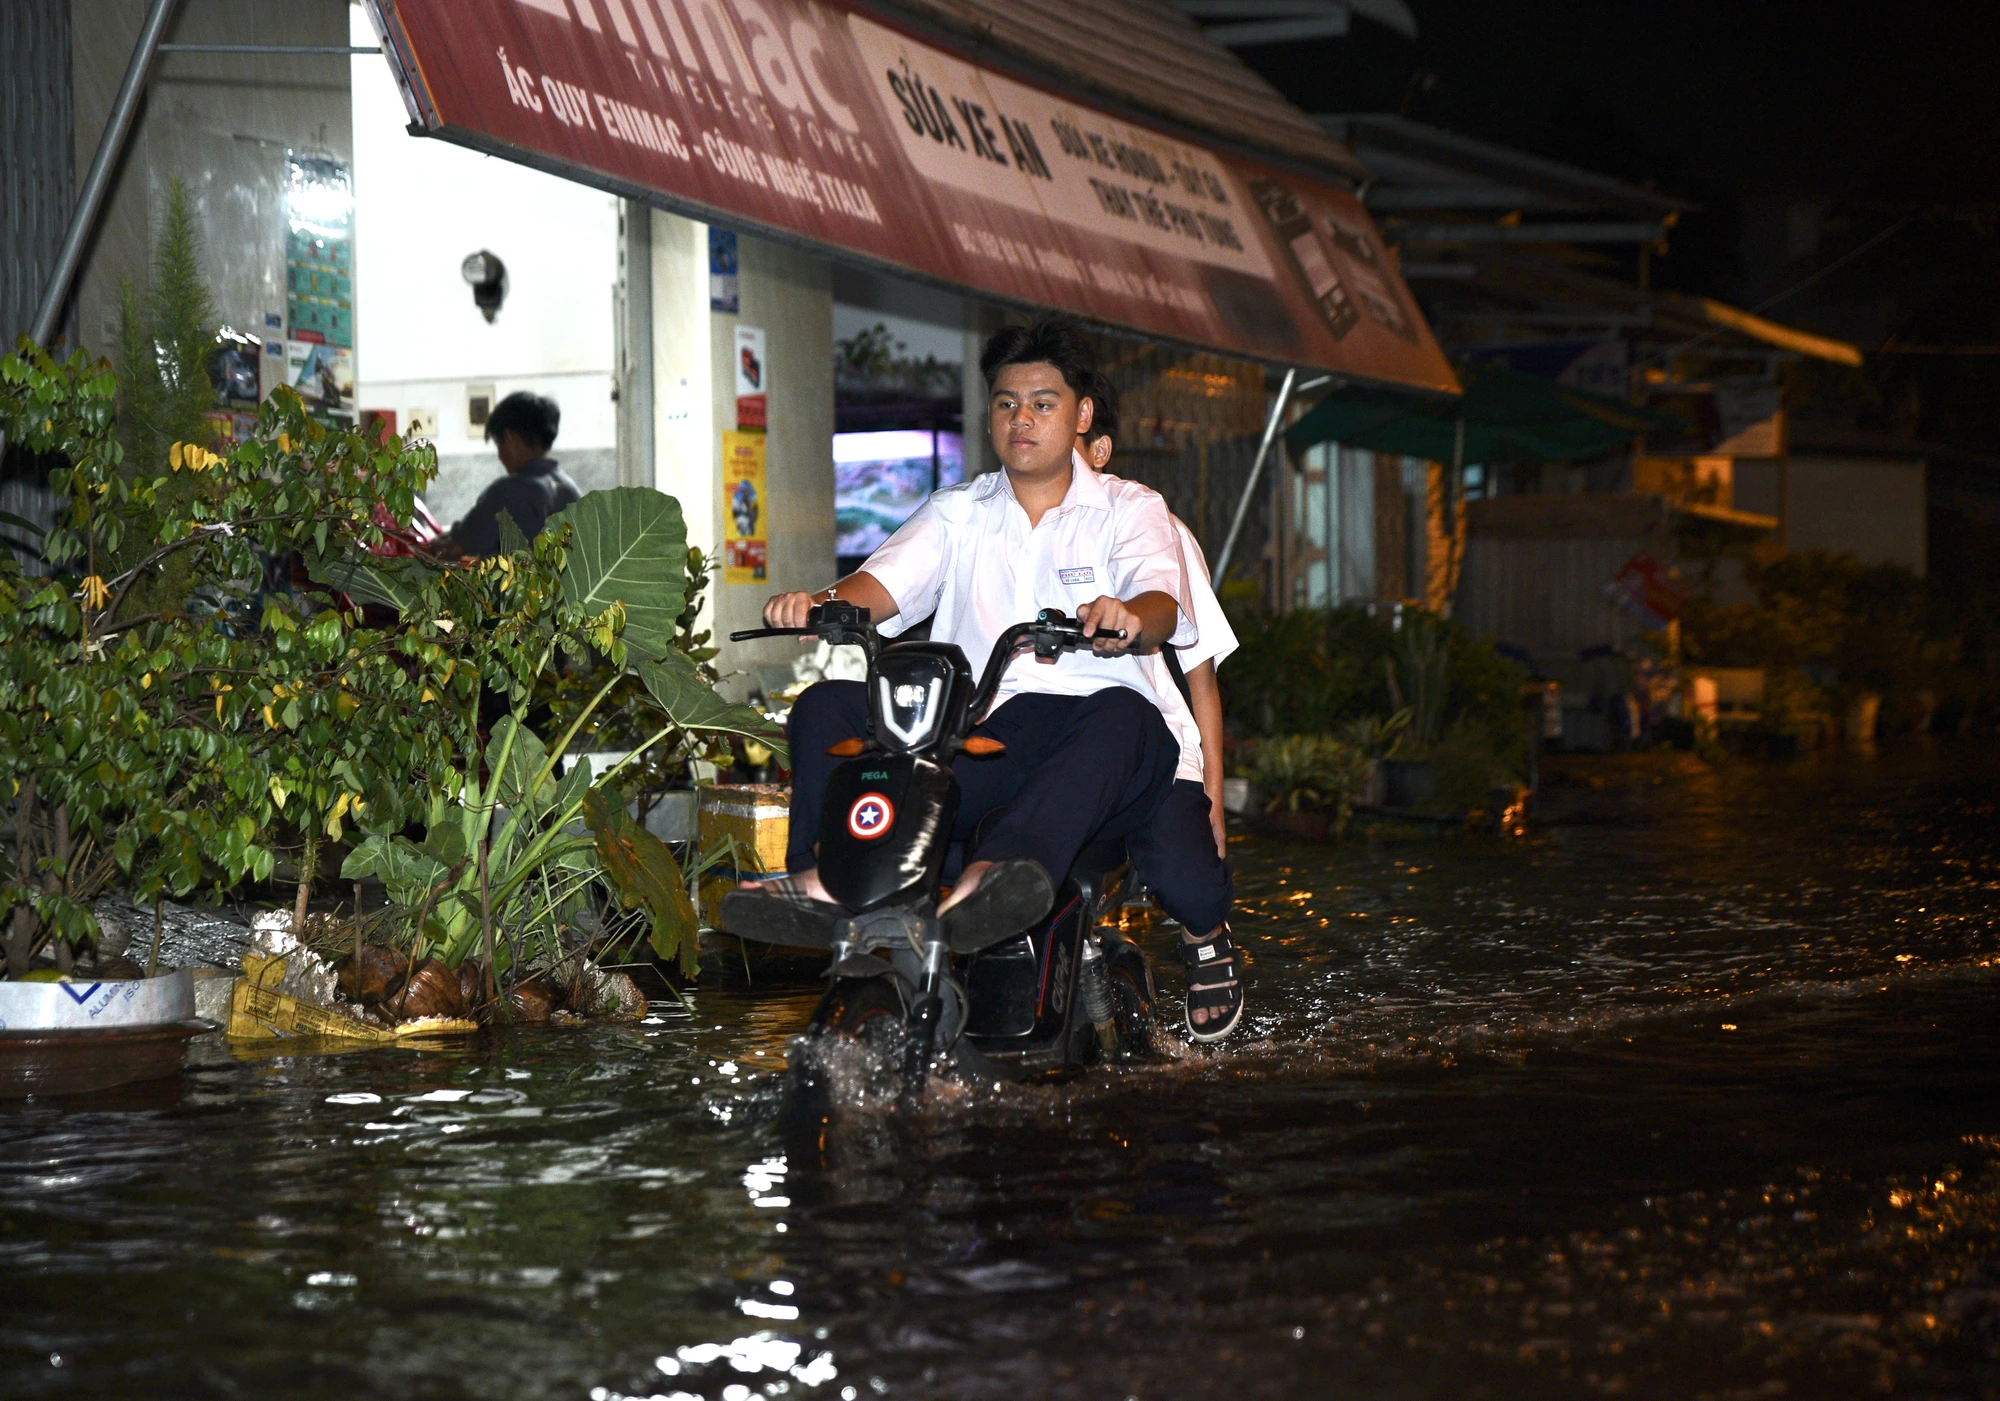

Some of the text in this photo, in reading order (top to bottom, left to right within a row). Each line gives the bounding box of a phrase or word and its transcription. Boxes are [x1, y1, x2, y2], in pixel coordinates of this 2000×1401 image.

[541, 75, 597, 131] QUY
[593, 93, 690, 162] ENIMAC
[702, 127, 767, 188] CÔNG
[760, 152, 824, 214] NGHỆ
[815, 170, 883, 225] ITALIA
[625, 51, 879, 170] TIMELESS POWER
[887, 56, 1053, 182] SỬA XE AN
[861, 770, 889, 781] PEGA
[247, 1004, 274, 1020] WARNING
